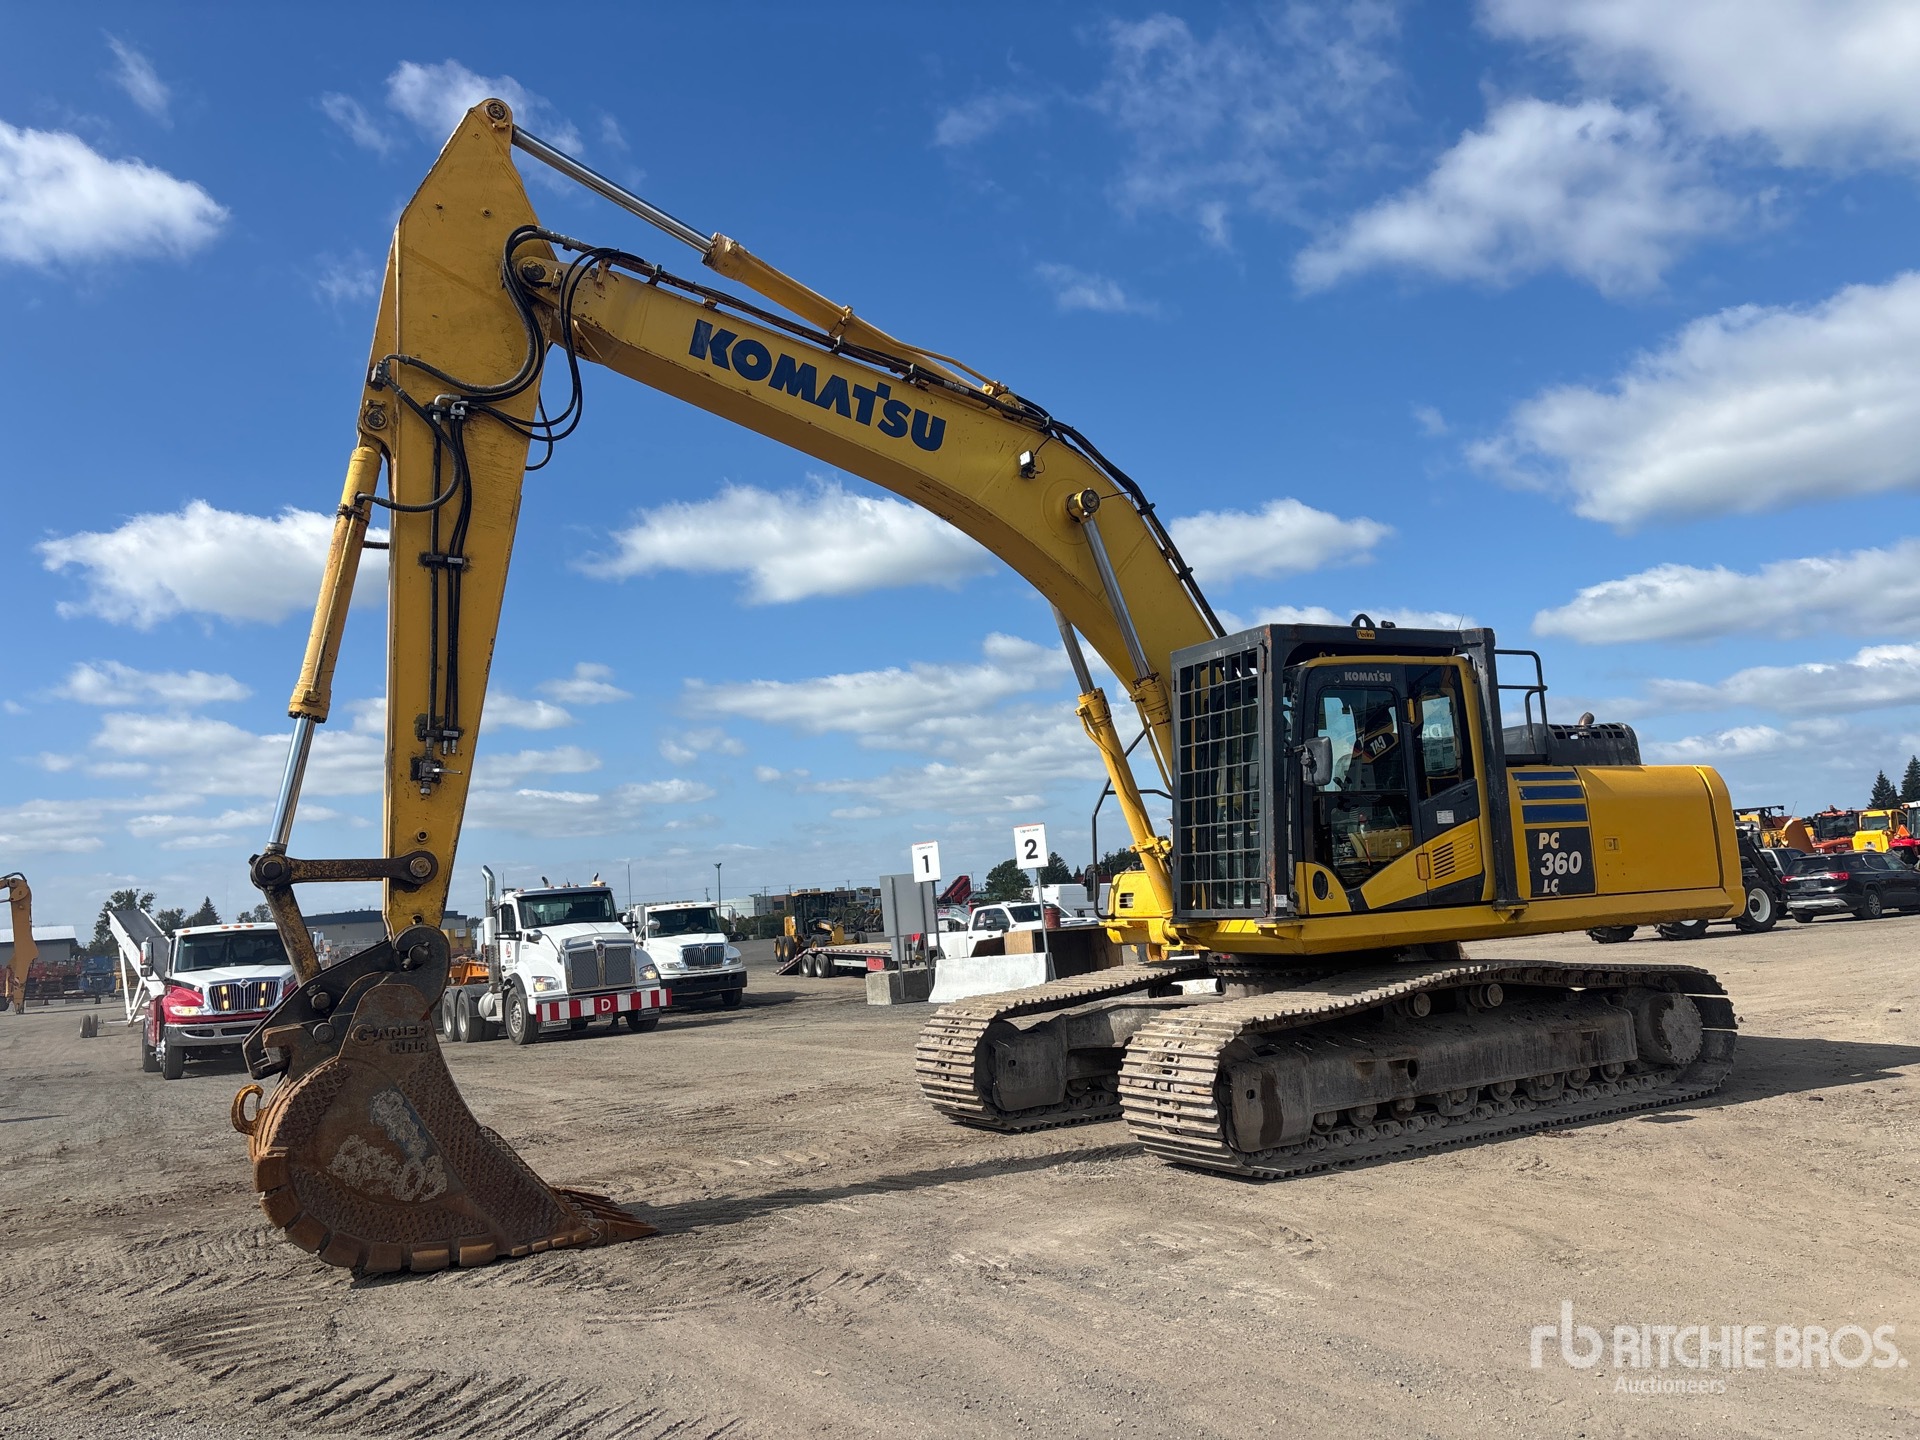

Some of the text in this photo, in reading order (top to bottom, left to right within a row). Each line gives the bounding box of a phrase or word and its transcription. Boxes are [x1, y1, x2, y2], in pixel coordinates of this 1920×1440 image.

[688, 318, 947, 452] KOMATSU
[1344, 670, 1392, 682] KOMATSU
[1024, 838, 1039, 860] 2
[1538, 831, 1560, 850] PC
[922, 854, 930, 874] 1
[1540, 851, 1583, 876] 360
[1542, 878, 1559, 894] LC
[601, 998, 611, 1012] D
